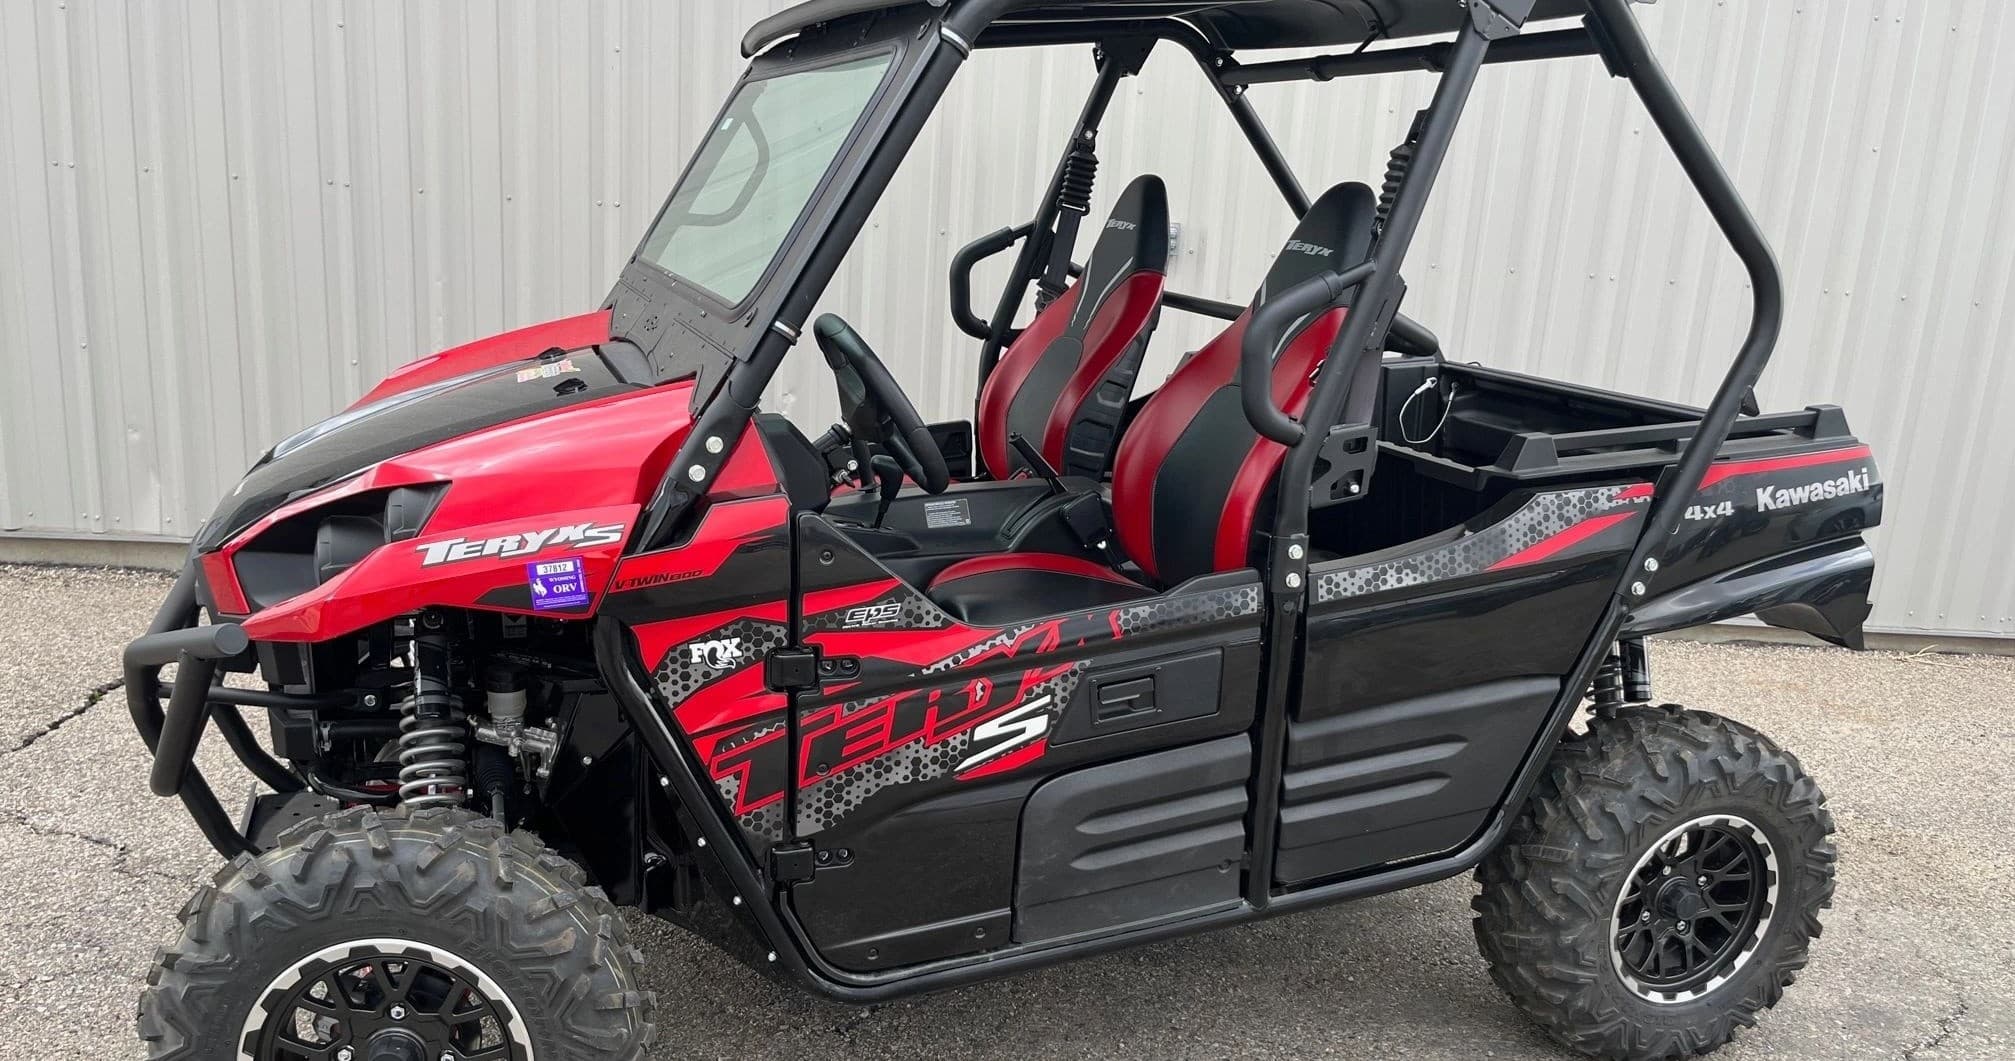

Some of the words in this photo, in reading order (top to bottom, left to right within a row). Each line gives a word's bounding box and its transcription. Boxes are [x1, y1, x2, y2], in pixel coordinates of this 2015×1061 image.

[1285, 239, 1335, 257] TERYX
[1755, 467, 1870, 513] Kawasaki
[1683, 500, 1736, 521] 4x4
[543, 563, 568, 574] 37812
[548, 574, 577, 583] WYOMING
[552, 582, 578, 594] ORV
[688, 637, 744, 669] FOX
